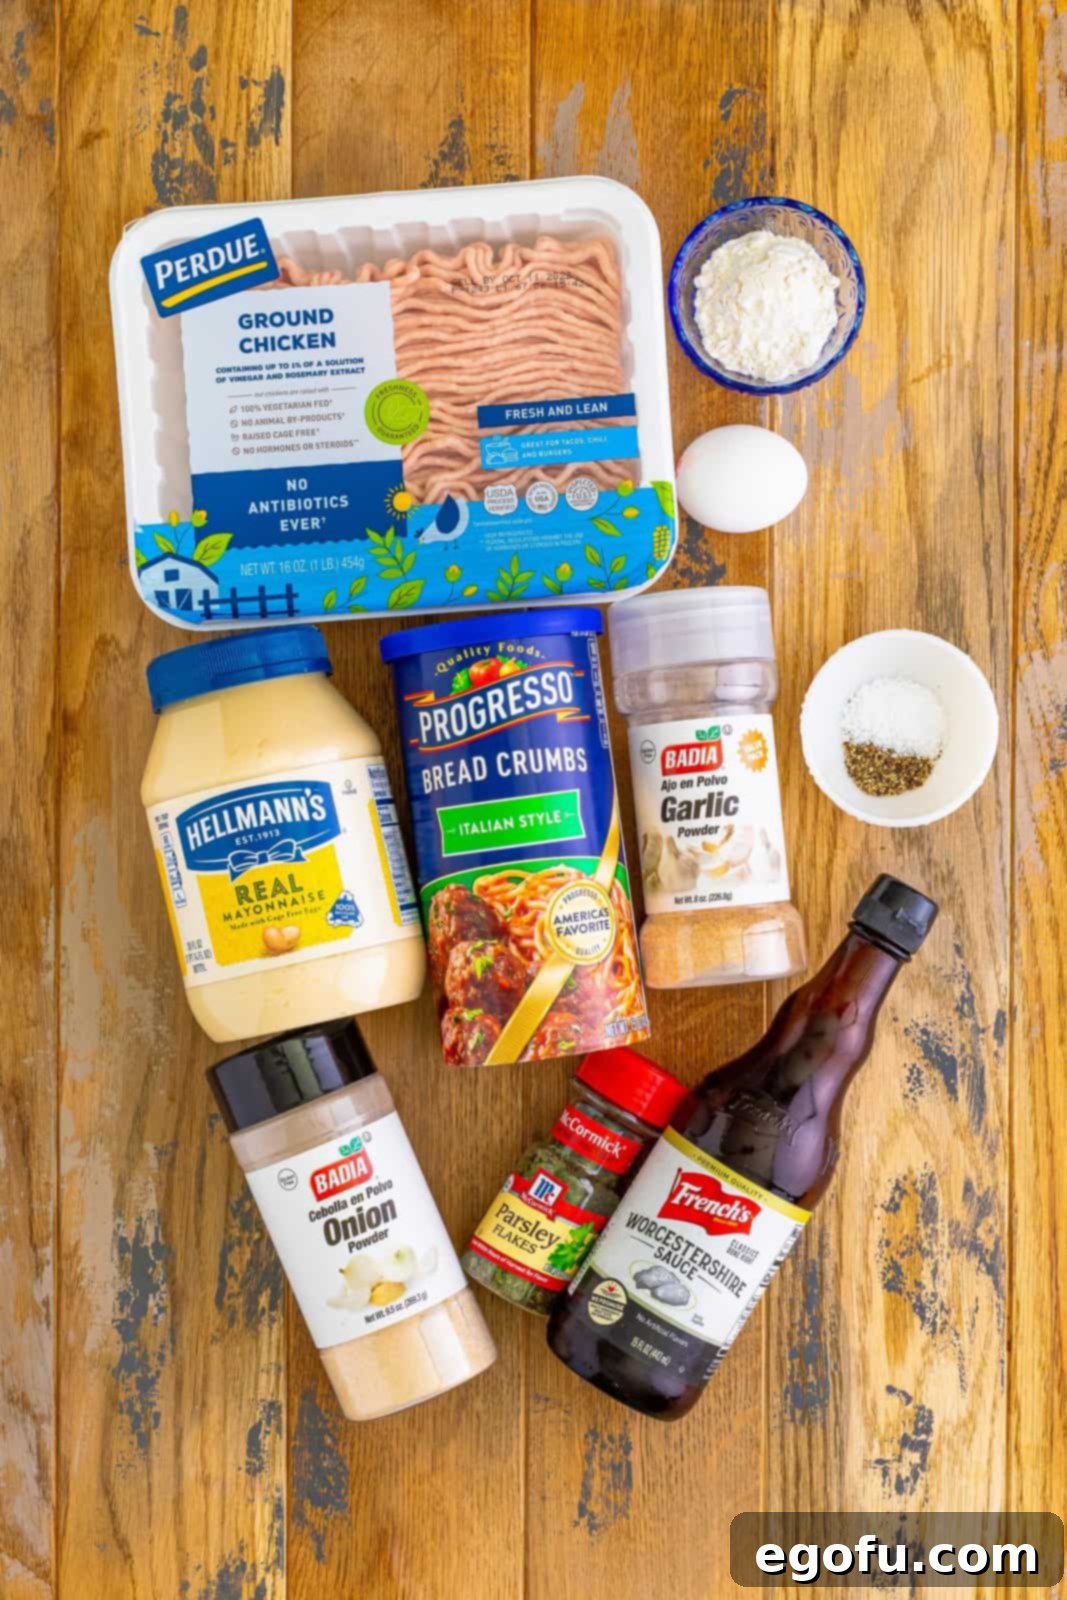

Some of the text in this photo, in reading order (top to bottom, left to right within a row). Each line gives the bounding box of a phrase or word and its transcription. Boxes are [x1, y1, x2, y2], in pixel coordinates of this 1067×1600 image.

[154, 233, 259, 290] PERDUE
[238, 308, 334, 330] GROUND
[239, 332, 336, 354] CHICKEN
[215, 364, 264, 374] CONTAINING
[265, 363, 276, 371] UP
[278, 362, 290, 370] TO
[303, 360, 314, 368] OF
[325, 357, 364, 366] SOLUTION
[215, 367, 366, 384] OF VINEGAR AND ROSEMARY EXTRACT
[240, 404, 262, 413] 100%
[263, 401, 313, 412] VEGETARIAN
[505, 402, 609, 420] FRESH AND LEAN
[241, 419, 253, 427] NO
[254, 415, 285, 426] ANIMAL
[242, 430, 272, 441] RAISED
[273, 429, 294, 439] CAGE
[520, 440, 544, 449] GREAT
[545, 439, 560, 447] FOR
[243, 446, 255, 455] NO
[256, 443, 301, 454] HORMONES
[302, 442, 314, 450] OR
[522, 448, 573, 459] AND BURGERS
[286, 478, 308, 492] NO
[486, 488, 513, 498] USDA
[248, 495, 349, 515] ANTIBIOTICS
[240, 562, 259, 577] NET
[279, 560, 292, 574] 16
[341, 555, 365, 571] 454g
[436, 645, 491, 673] Quality
[418, 671, 574, 744] PROGRESSO
[422, 747, 588, 794] BREAD CRUMBS
[665, 746, 718, 770] BADIA
[660, 775, 728, 793] Ajo en Polvo
[185, 788, 328, 852] HELLMANN'S
[660, 791, 740, 823] Garlic
[458, 810, 562, 836] ITALIAN STYLE
[677, 823, 720, 838] Powder
[234, 873, 304, 907] REAL
[222, 890, 327, 923] MAYONNAISE
[230, 920, 249, 932] Made
[250, 917, 265, 928] with
[266, 913, 286, 925] Cage
[287, 909, 303, 920] Free
[304, 905, 322, 918] Eggs
[556, 919, 610, 938] FAVORITE
[559, 1109, 622, 1160] McCormick
[314, 1157, 369, 1195] BADIA
[694, 1154, 763, 1200] PREMIUM QUALITY
[308, 1179, 394, 1223] Cebolla en Polvo
[672, 1181, 752, 1224] French's
[323, 1198, 398, 1246] Onion
[494, 1203, 561, 1250] Parsley
[347, 1228, 390, 1254] Powder
[491, 1223, 539, 1255] FLAKES
[625, 1212, 748, 1298] WORCESTERSHIRE
[653, 1244, 698, 1281] SAUCE
[635, 1312, 646, 1323] No
